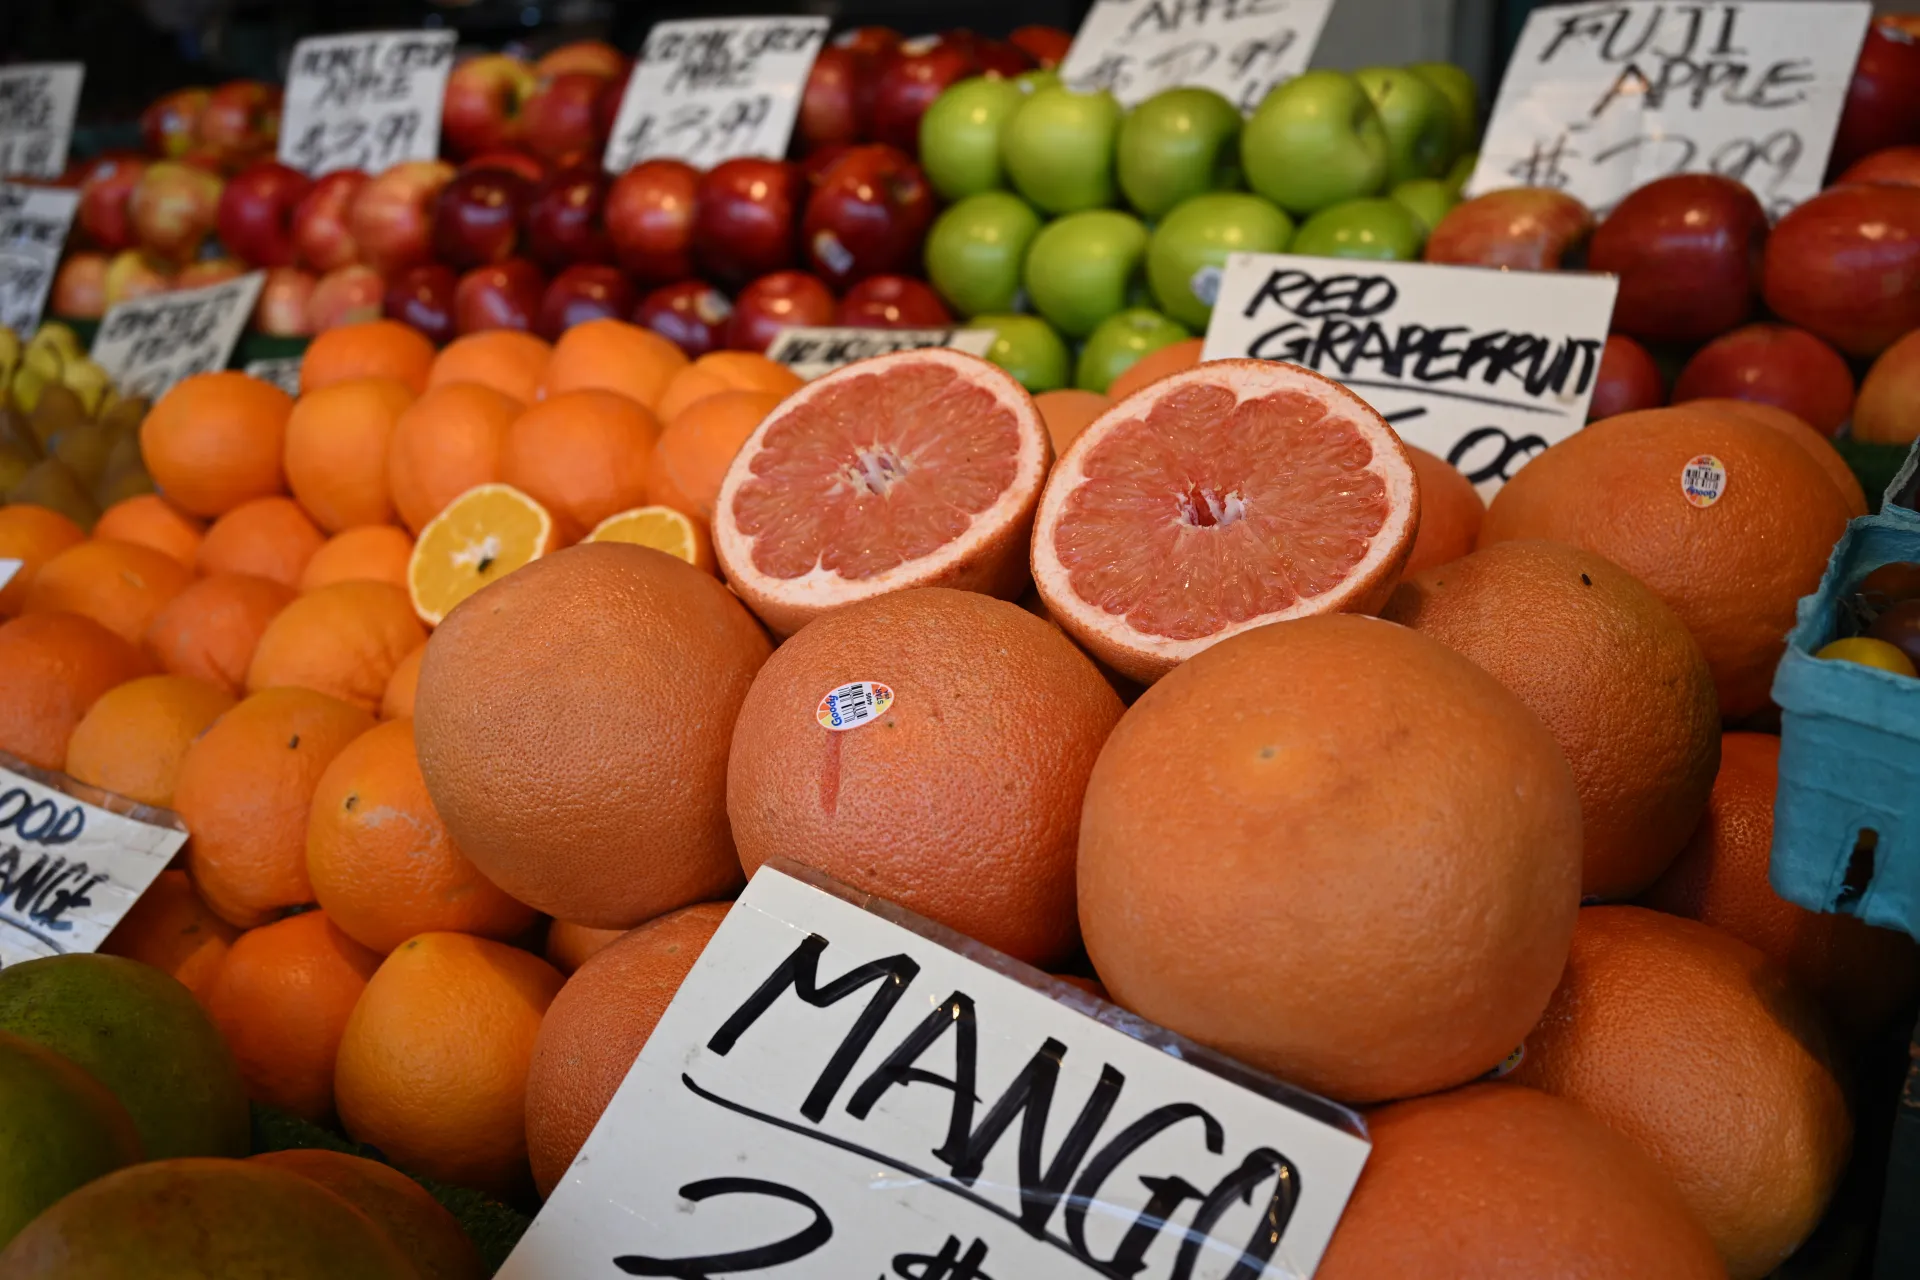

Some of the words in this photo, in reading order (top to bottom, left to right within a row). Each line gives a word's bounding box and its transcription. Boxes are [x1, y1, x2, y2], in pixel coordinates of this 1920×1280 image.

[1538, 3, 1748, 62] FUJI
[1589, 57, 1815, 118] APPLE
[1243, 265, 1399, 319] RED
[1247, 320, 1601, 399] GRAPEFRUIT
[826, 695, 842, 726] Goody
[875, 688, 883, 704] STAR
[706, 932, 1303, 1280] MANGO
